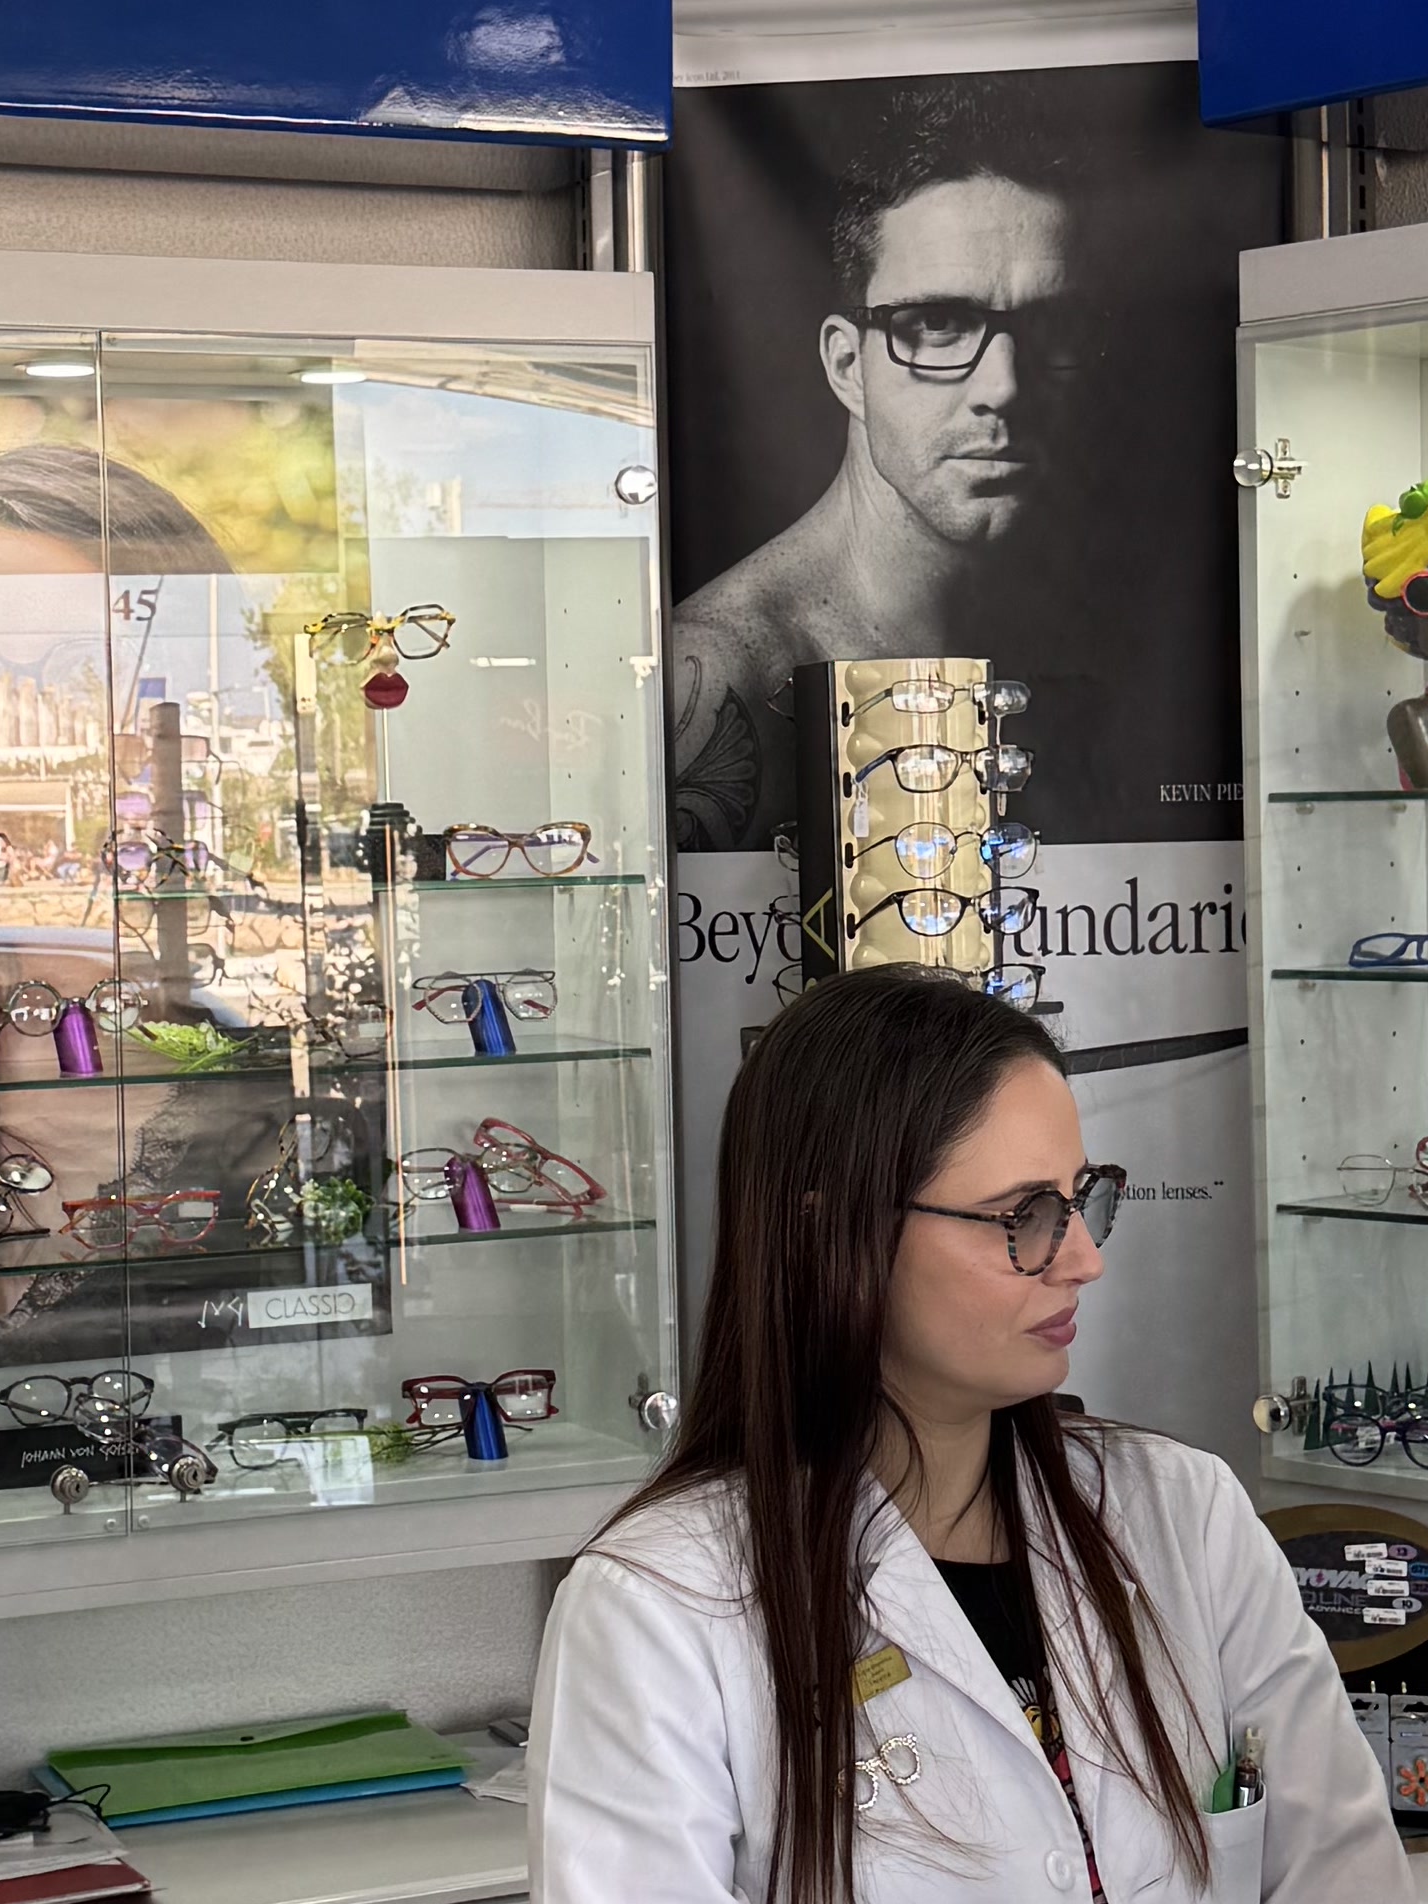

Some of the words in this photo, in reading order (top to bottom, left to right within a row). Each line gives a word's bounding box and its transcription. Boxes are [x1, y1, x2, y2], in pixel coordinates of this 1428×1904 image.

[113, 589, 158, 622] 45
[1160, 783, 1212, 802] KEVIN
[265, 1292, 356, 1320] CLASSIC
